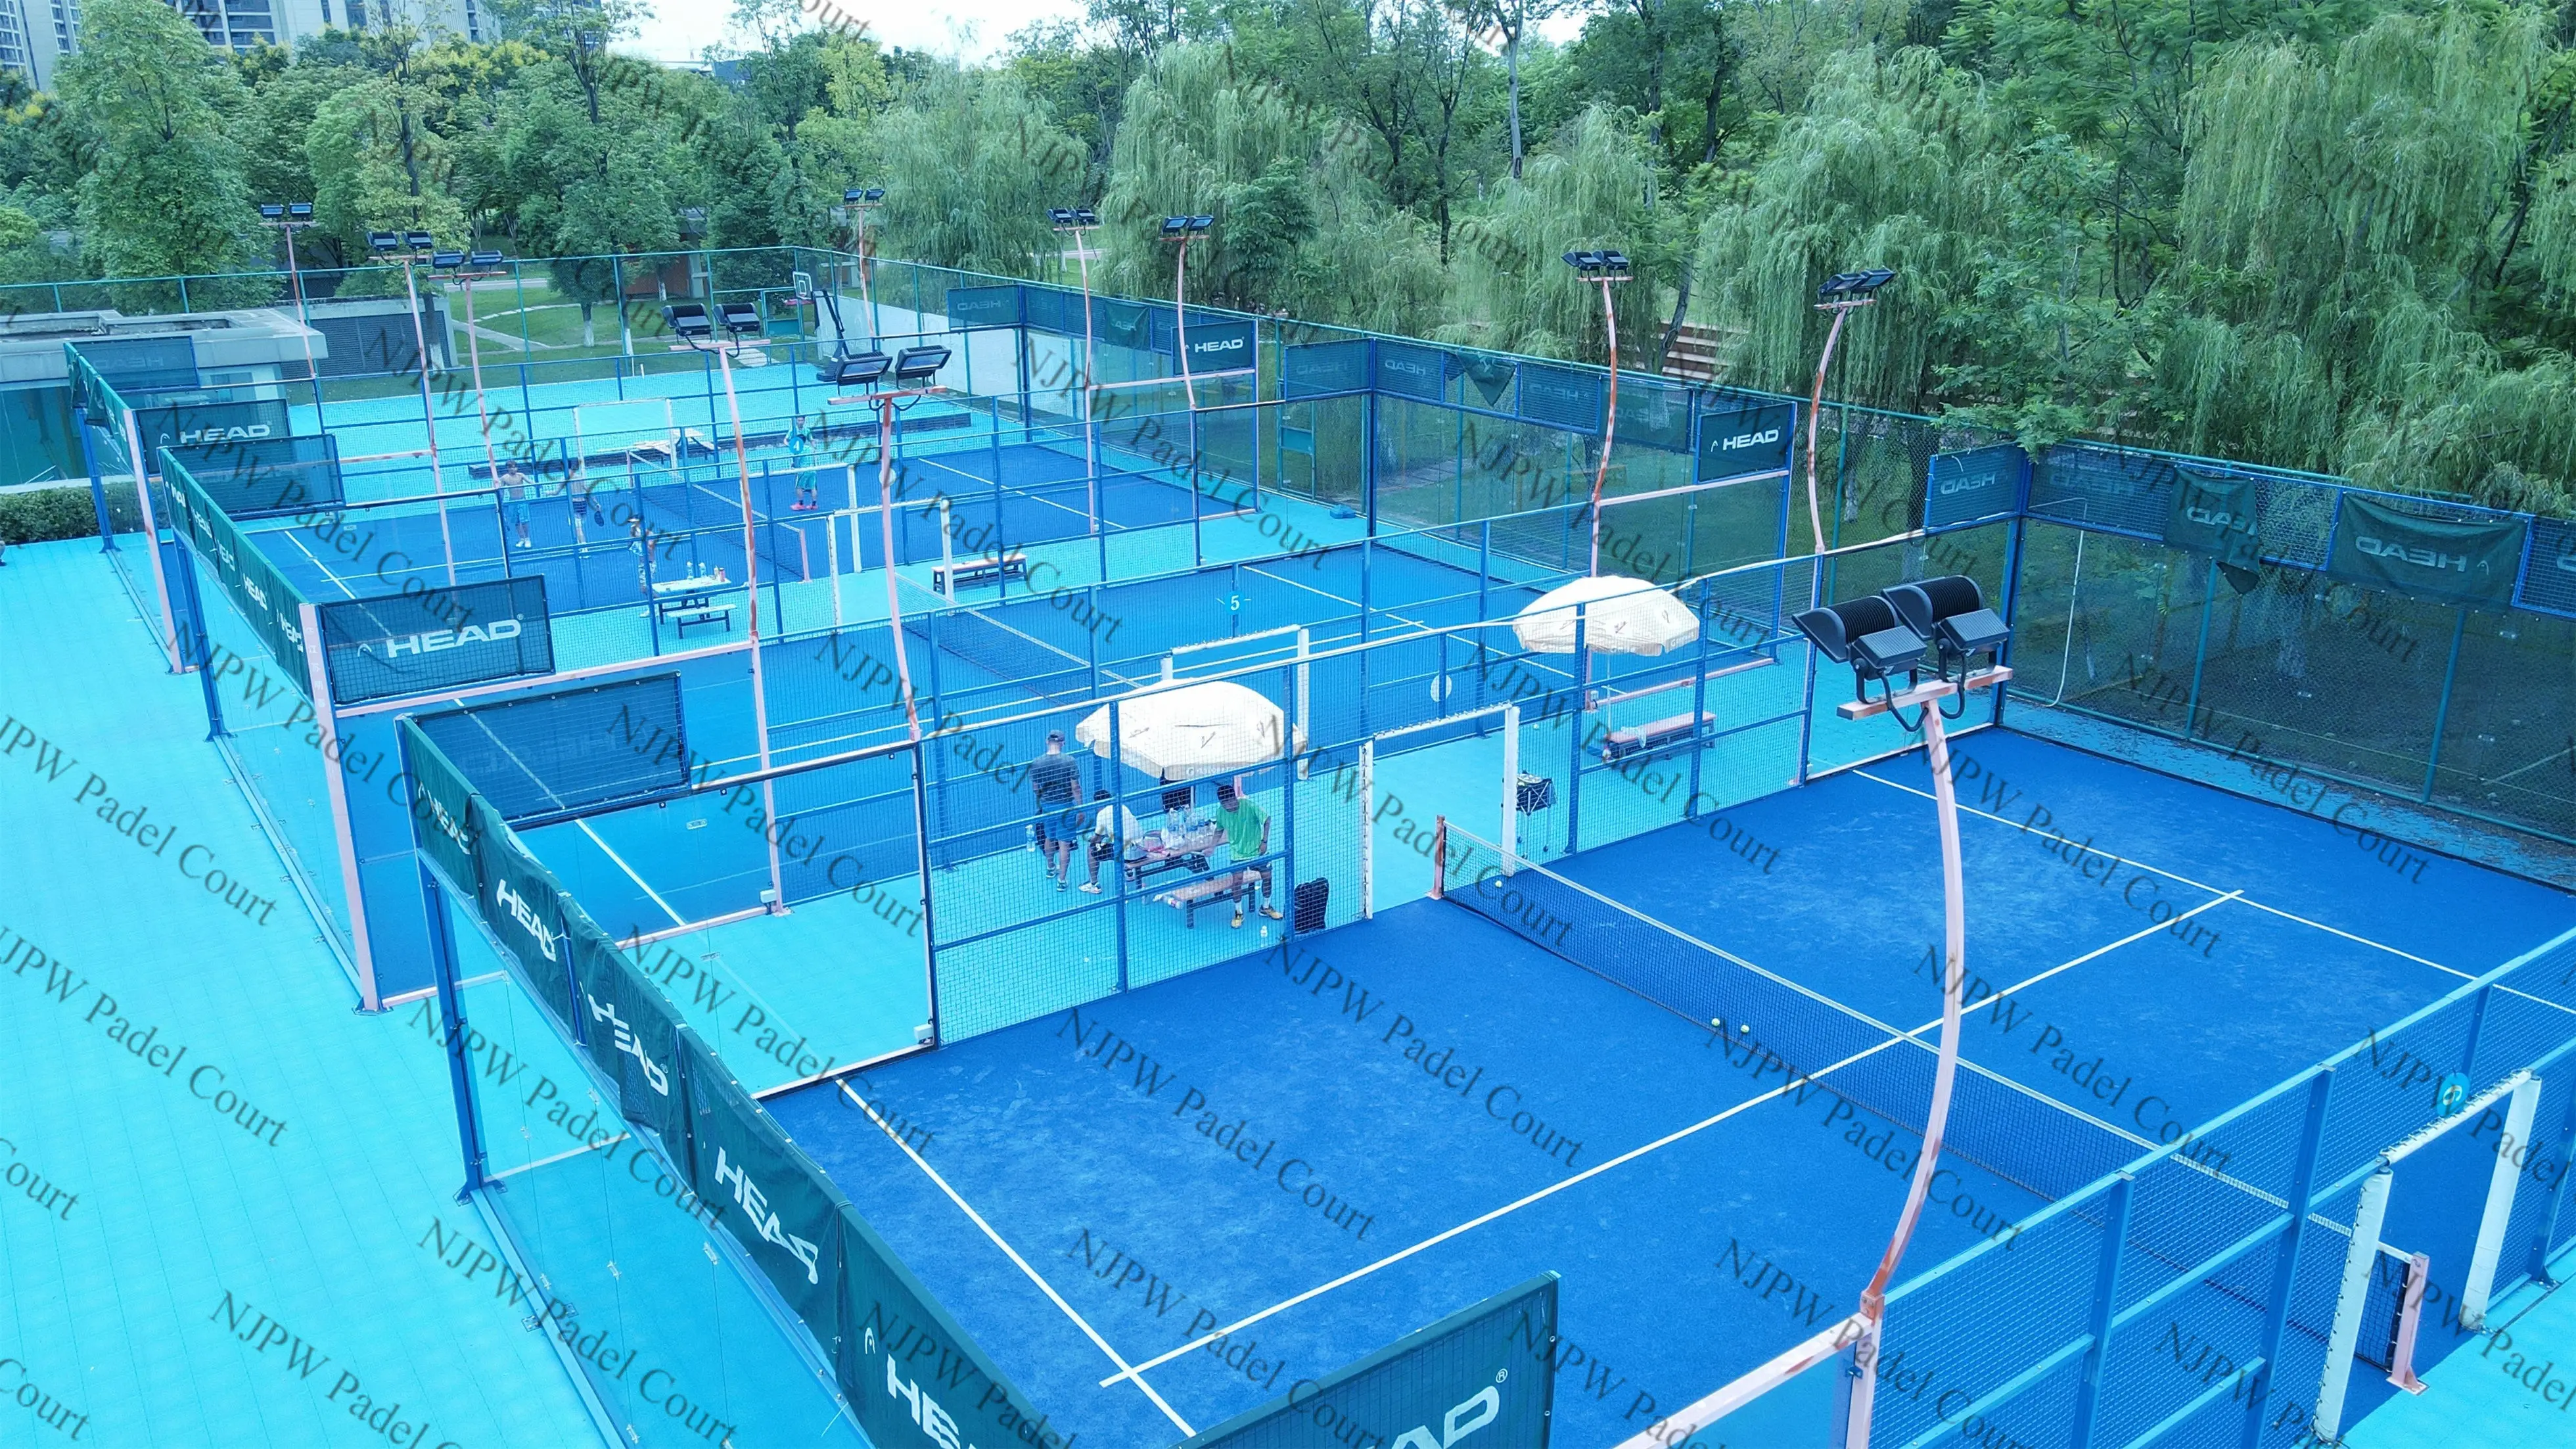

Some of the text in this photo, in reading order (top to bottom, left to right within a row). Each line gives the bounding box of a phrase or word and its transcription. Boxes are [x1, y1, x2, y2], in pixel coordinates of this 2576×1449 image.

[1194, 339, 1244, 354] HEAD
[179, 424, 271, 444] HEAD
[793, 440, 800, 451] 4
[1722, 428, 1780, 451] HEAD
[1230, 595, 1240, 610] 5
[386, 619, 521, 658] HEAD
[497, 879, 557, 962] HEAD
[588, 994, 668, 1097] HEAD
[2443, 1085, 2462, 1105] 6
[715, 1146, 819, 1285] HEAD
[887, 1354, 977, 1449] HE
